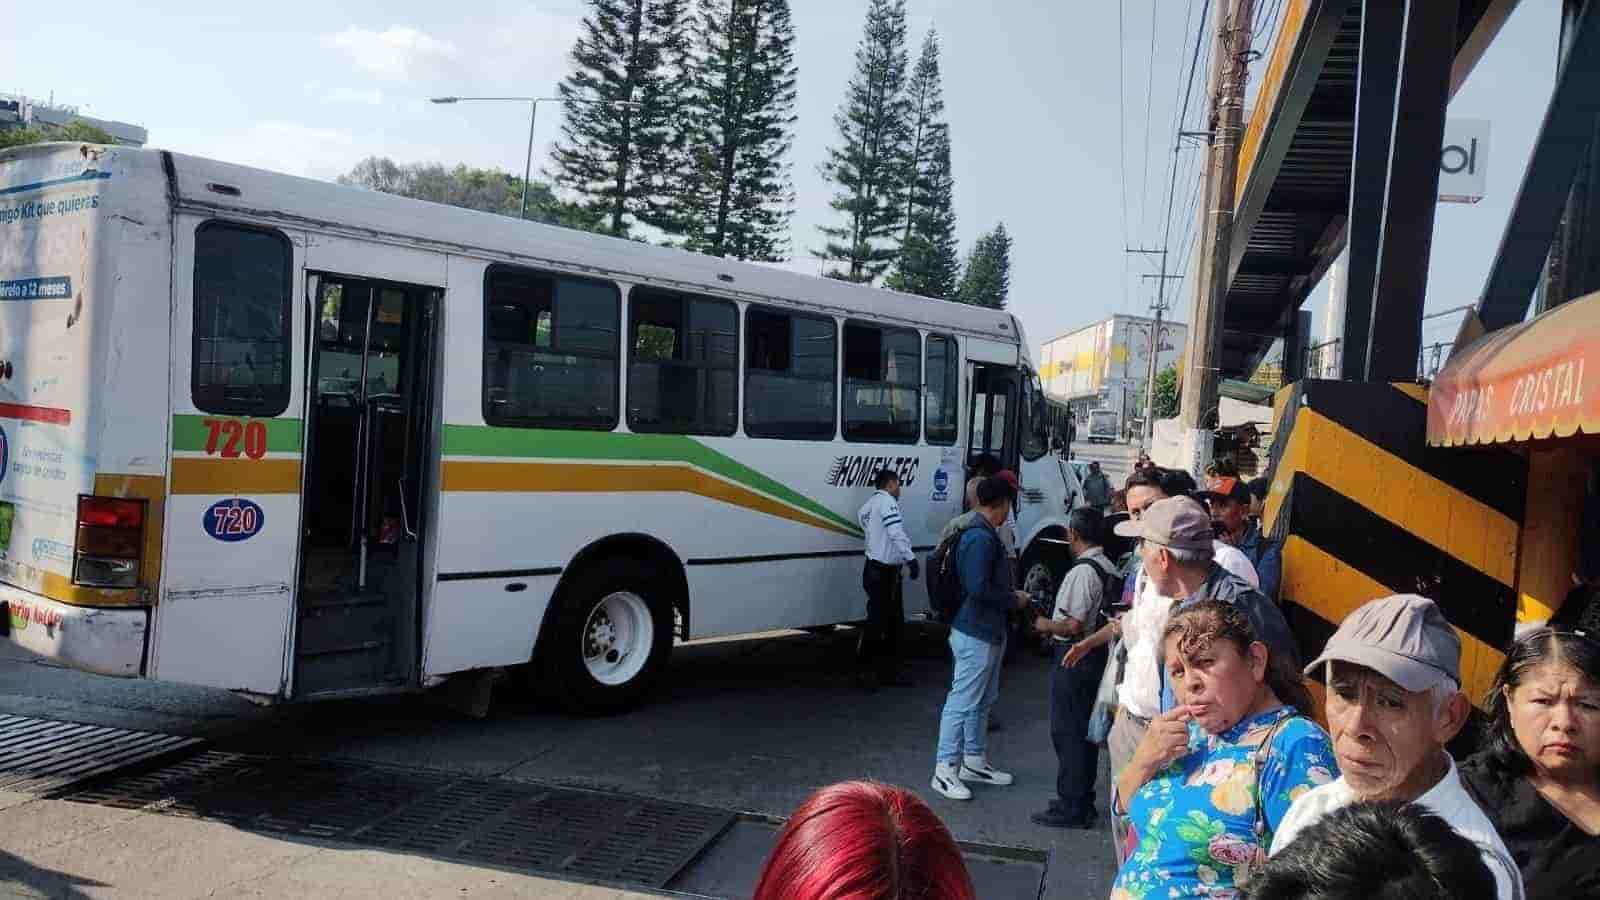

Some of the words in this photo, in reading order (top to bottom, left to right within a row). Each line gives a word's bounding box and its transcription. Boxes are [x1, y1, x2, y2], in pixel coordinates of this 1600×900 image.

[21, 202, 35, 218] Kit
[37, 200, 57, 219] que
[39, 282, 66, 296] meses
[1448, 384, 1496, 425] PAPAS
[1509, 357, 1585, 416] CRISTAL
[203, 419, 267, 460] 720
[896, 455, 920, 487] TEC
[214, 506, 257, 535] 720
